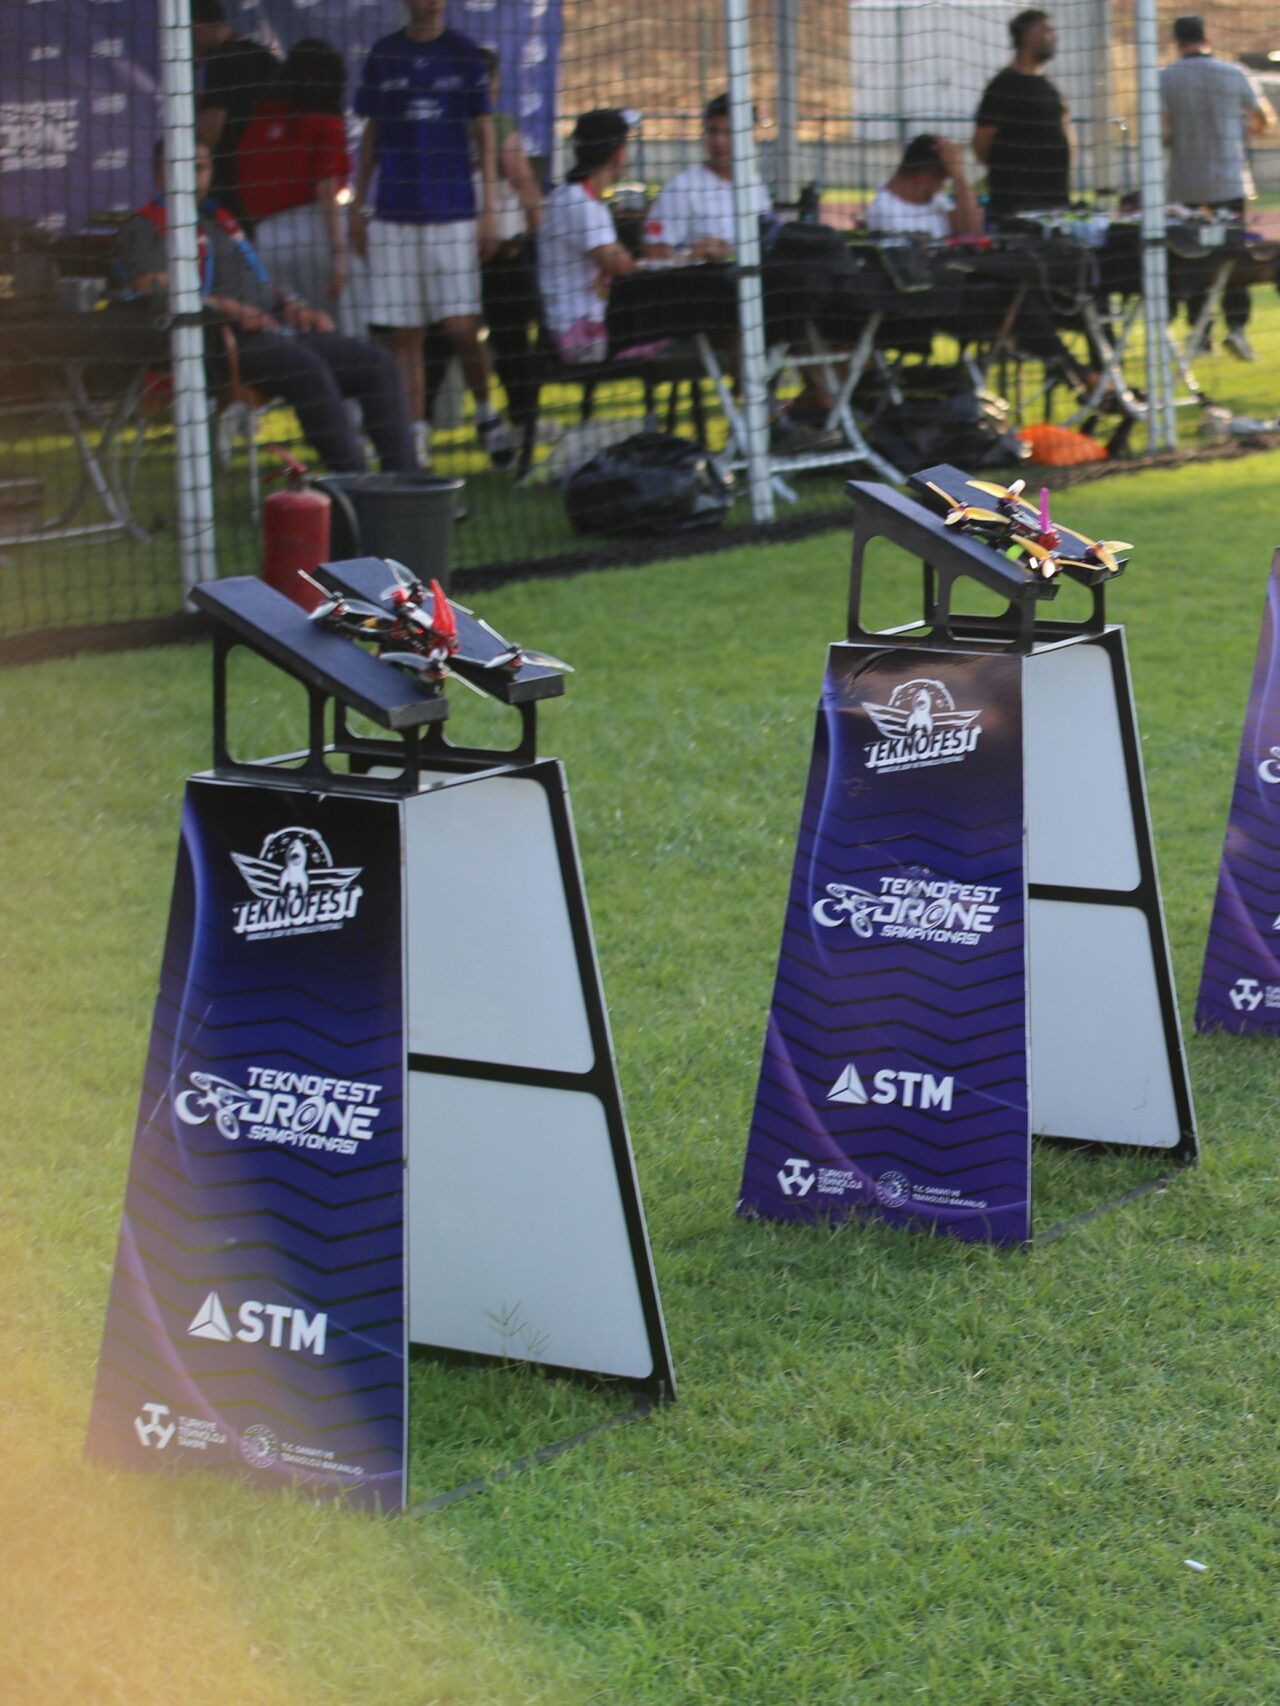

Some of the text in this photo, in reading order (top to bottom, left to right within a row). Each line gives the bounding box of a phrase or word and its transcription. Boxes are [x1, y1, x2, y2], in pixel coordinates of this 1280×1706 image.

[863, 725, 982, 768] TEKNOFEST
[232, 885, 364, 934] TEKNOFEST
[880, 877, 1001, 903] TEKNOFEST
[872, 895, 1000, 933] DRONE
[247, 1066, 383, 1104] TEKNOFEST
[871, 1069, 954, 1111] STM
[239, 1089, 381, 1140] DRONE
[236, 1300, 328, 1356] STM
